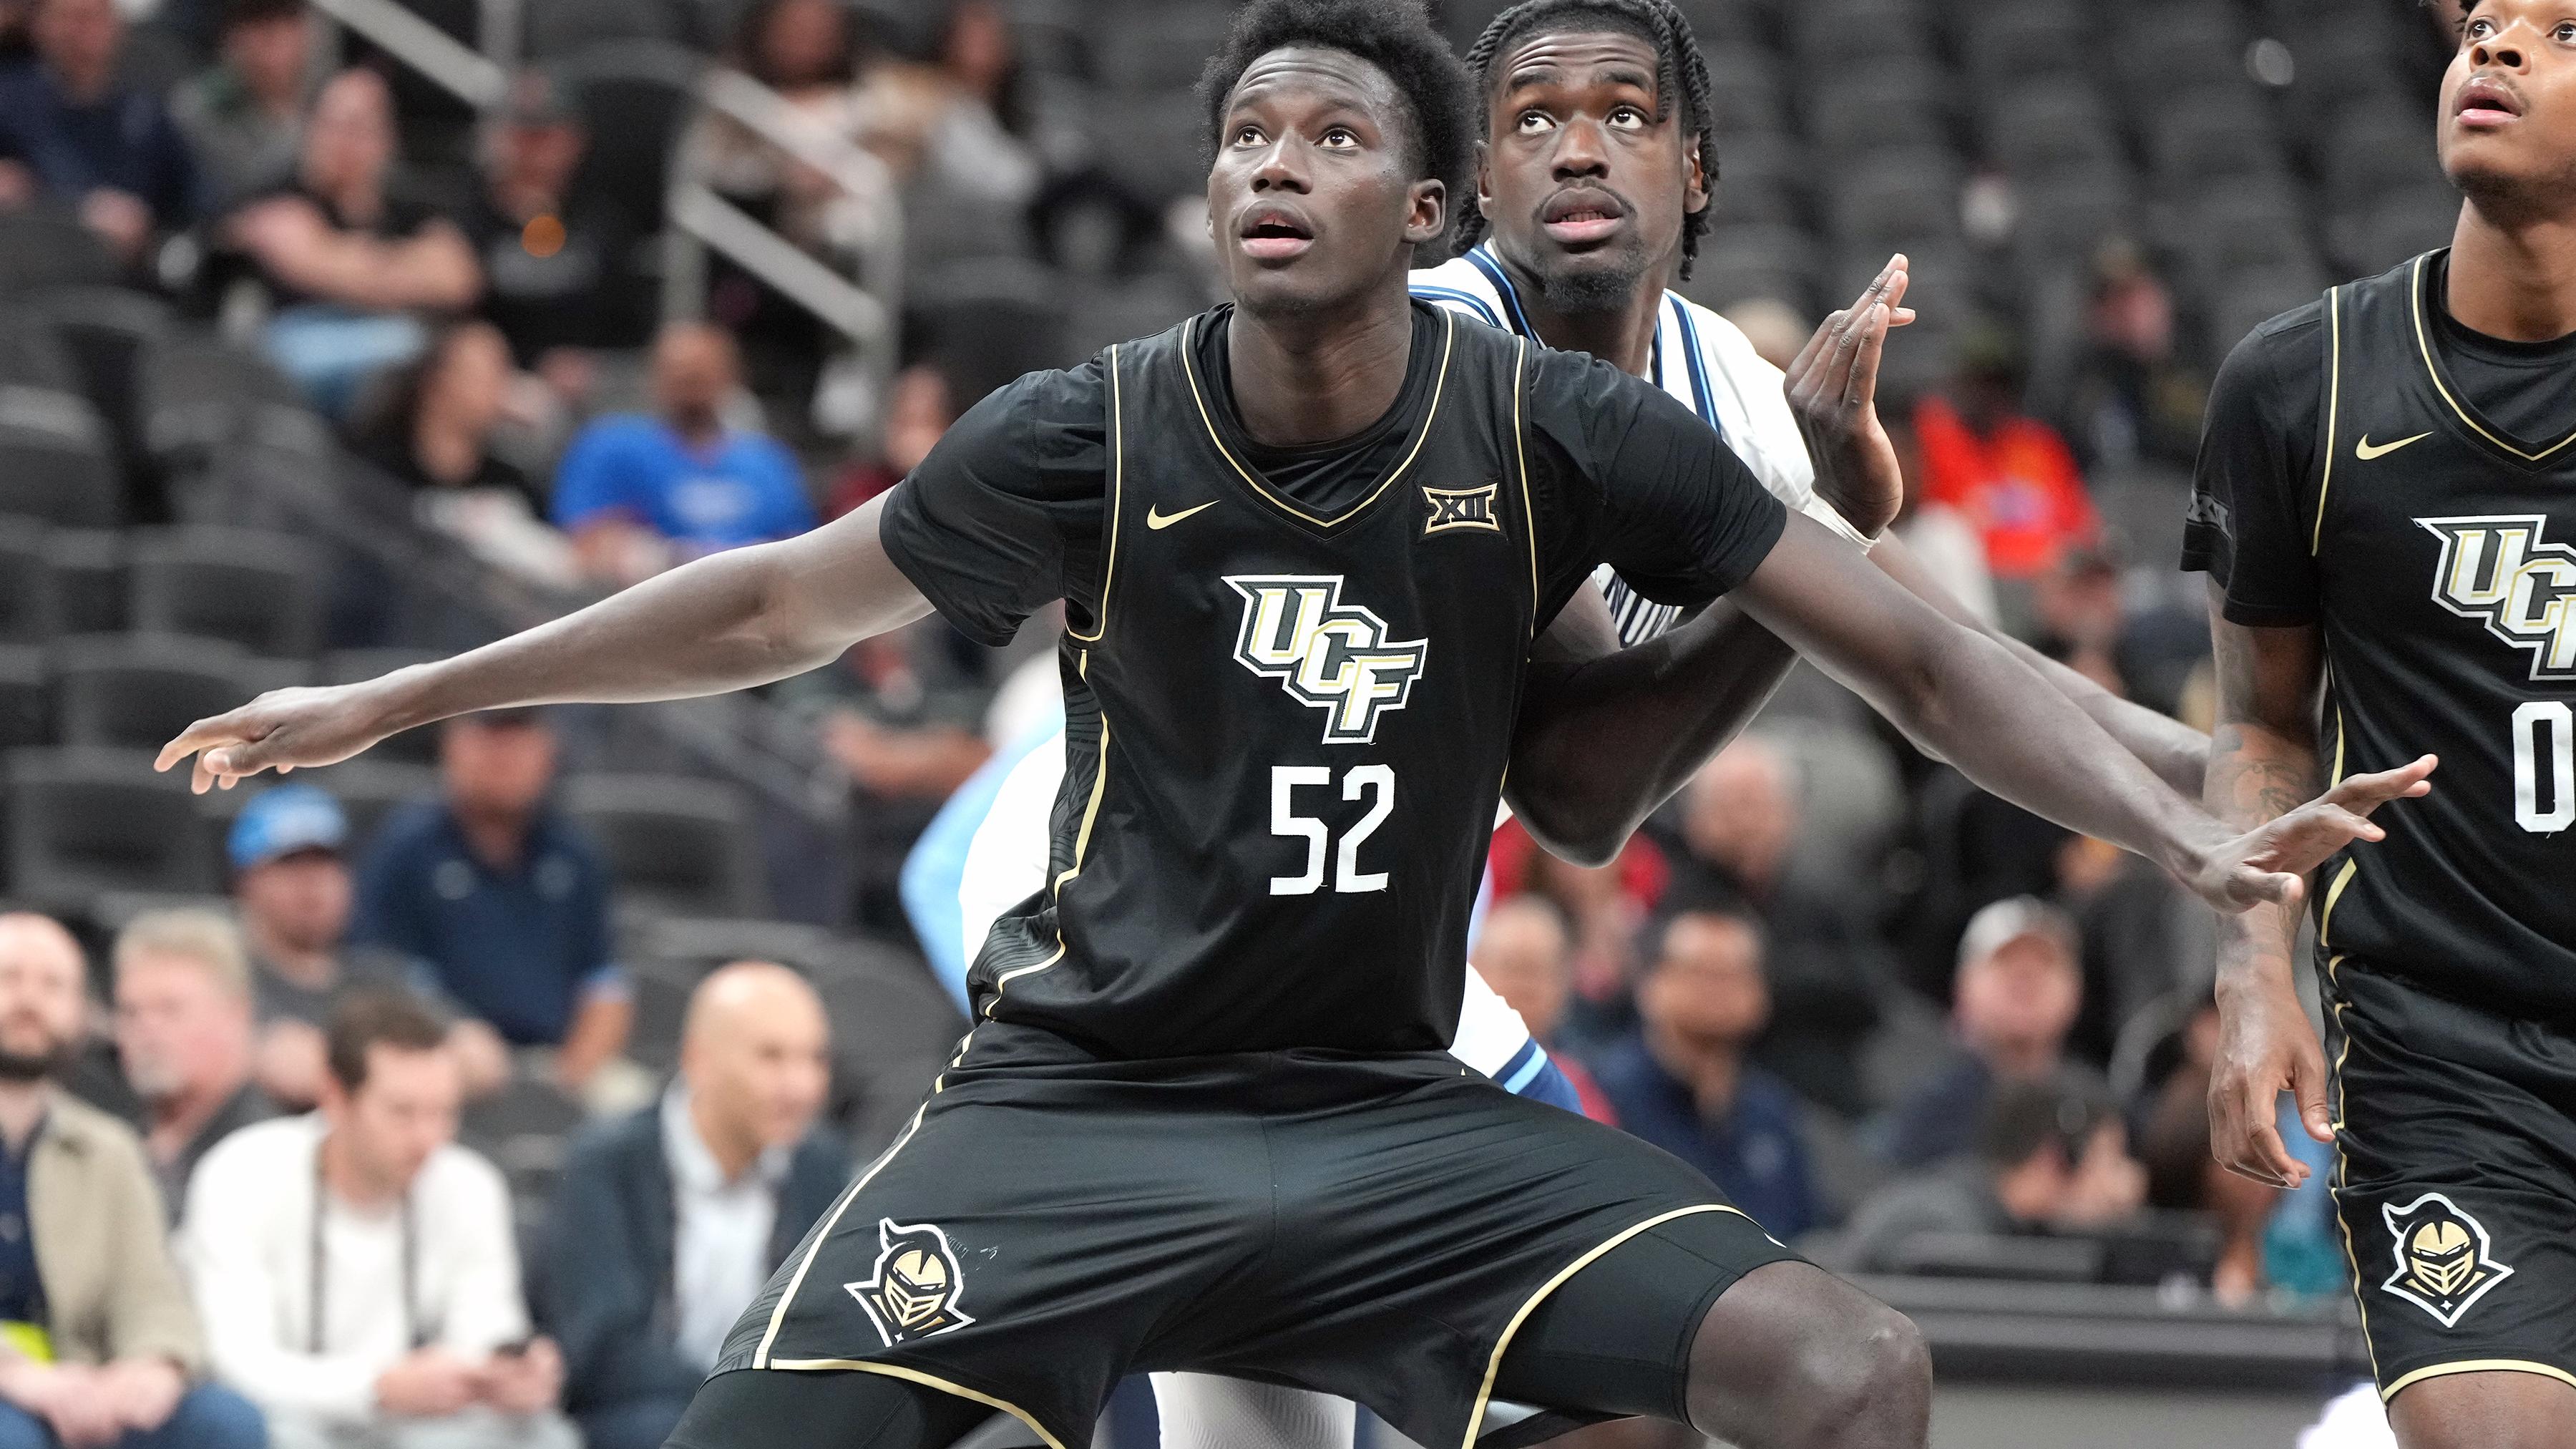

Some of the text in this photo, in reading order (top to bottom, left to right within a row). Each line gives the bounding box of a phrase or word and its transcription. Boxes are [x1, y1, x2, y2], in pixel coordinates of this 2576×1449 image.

[1423, 484, 1499, 534] XII
[1221, 575, 1428, 744] UCF
[1269, 764, 1395, 895] 52
[2512, 701, 2576, 833] 0
